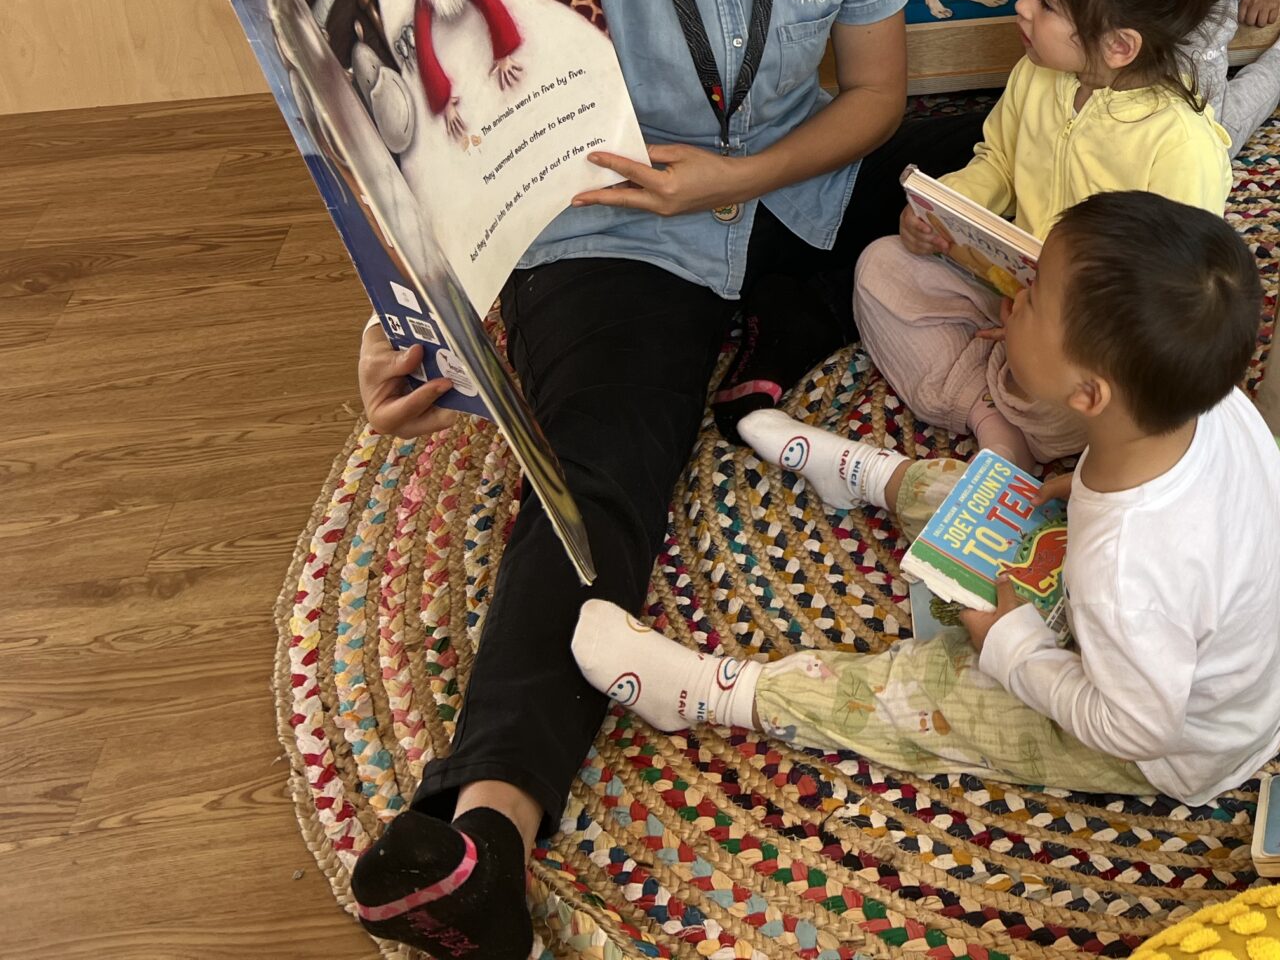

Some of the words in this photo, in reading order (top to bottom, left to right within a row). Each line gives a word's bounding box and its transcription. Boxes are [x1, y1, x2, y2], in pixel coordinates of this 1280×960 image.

[481, 122, 492, 136] The
[493, 107, 514, 128] animals
[515, 96, 532, 111] went
[532, 89, 540, 101] in
[541, 82, 555, 94] five
[556, 74, 568, 86] by
[494, 149, 515, 173] warmed
[515, 139, 529, 155] each
[530, 127, 547, 143] other
[549, 120, 556, 130] to
[557, 111, 576, 125] keep
[577, 101, 596, 115] alive
[522, 182, 531, 193] for
[531, 175, 539, 185] to
[538, 167, 549, 181] get
[550, 159, 561, 170] out
[562, 151, 571, 162] of
[572, 145, 585, 156] the
[586, 137, 606, 149] rain.
[944, 510, 978, 548] JOEY
[967, 463, 1012, 514] COUNTS
[962, 526, 1009, 565] TO
[987, 475, 1041, 532] TEN
